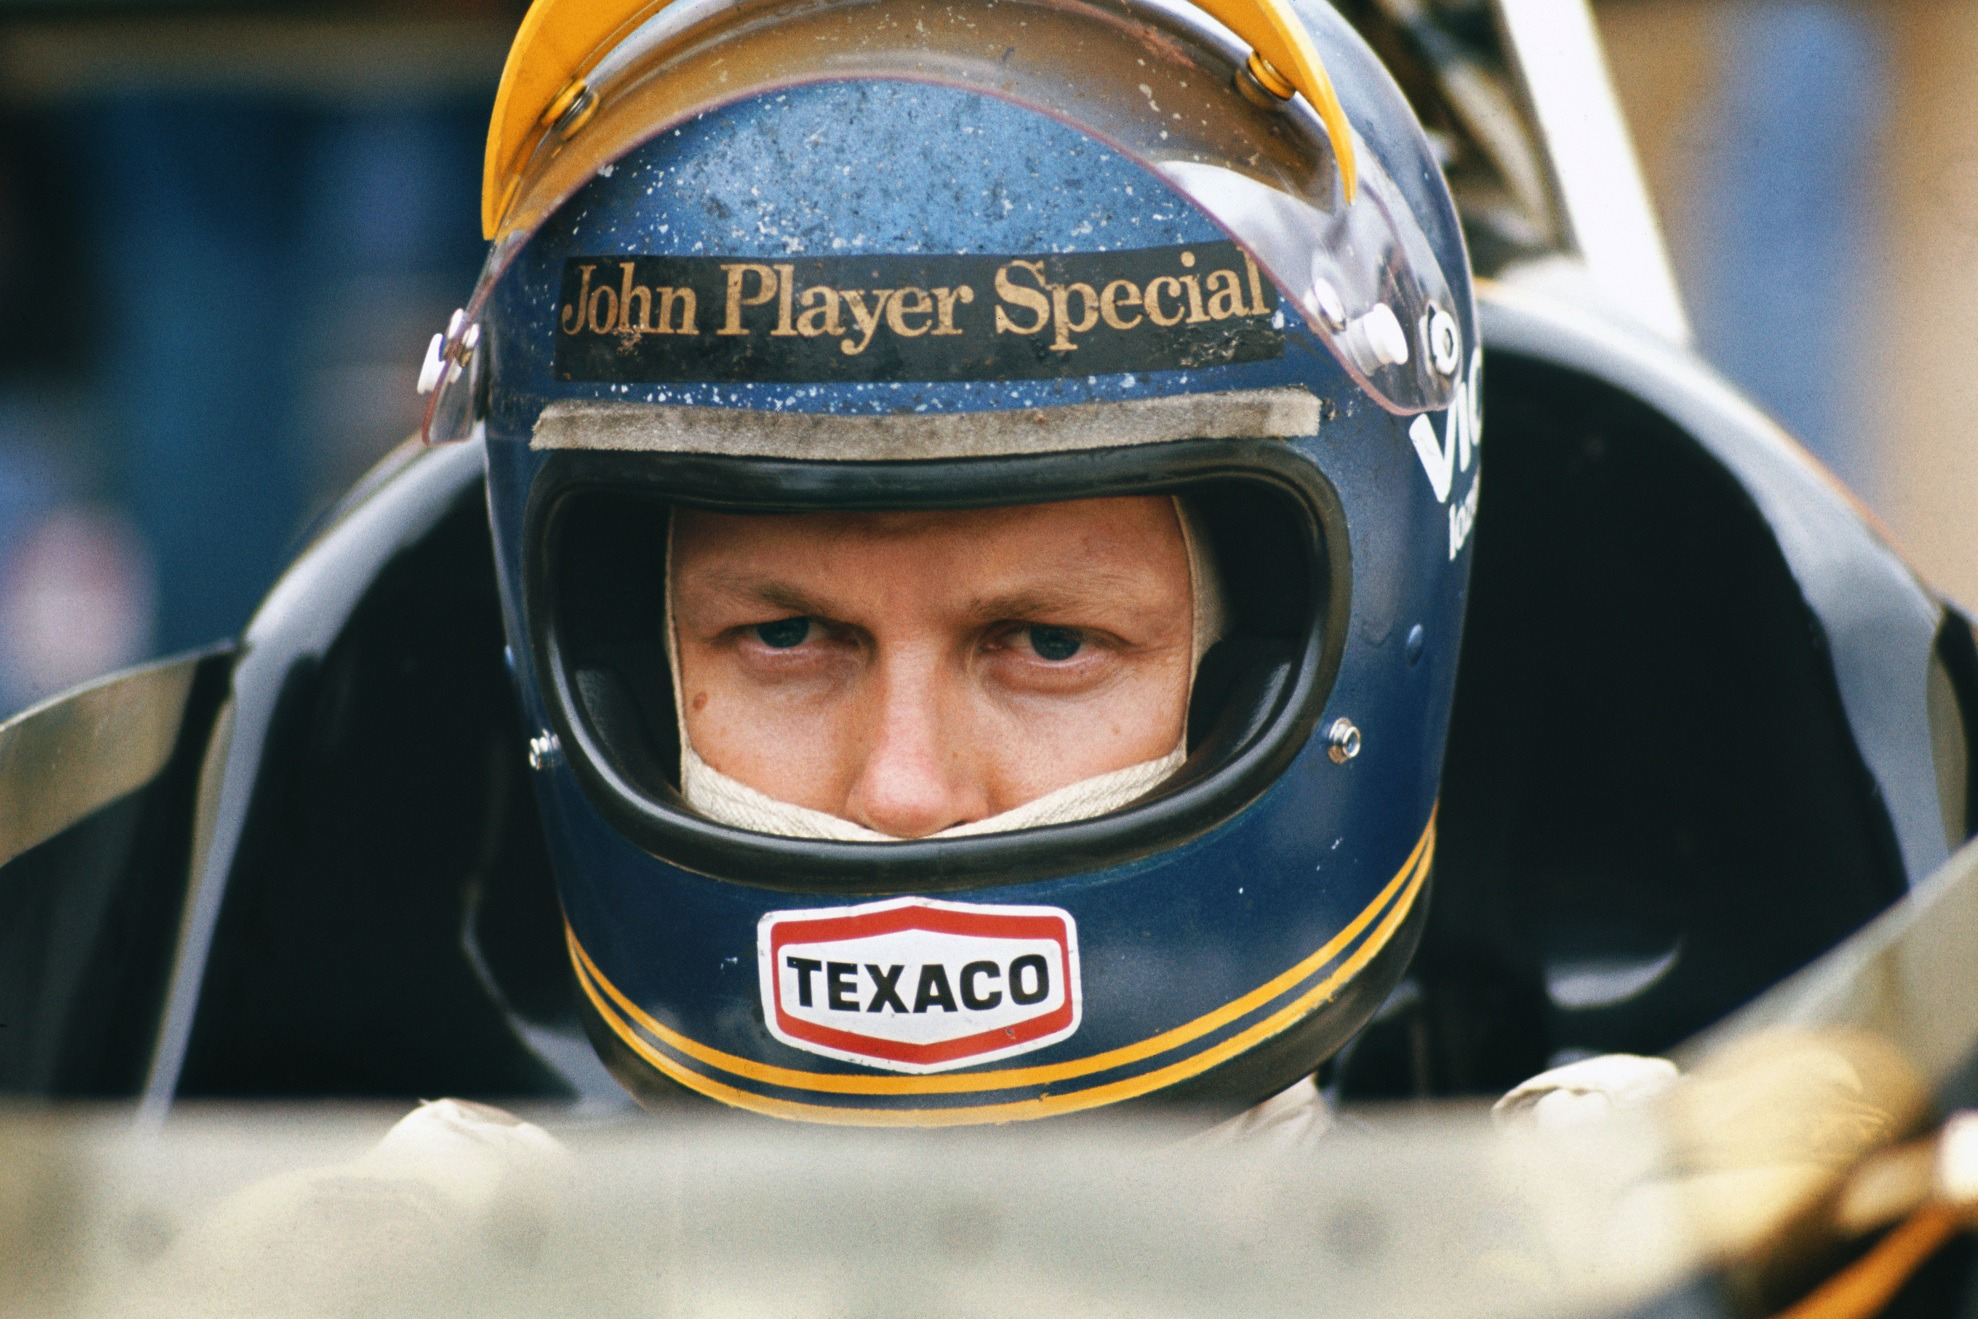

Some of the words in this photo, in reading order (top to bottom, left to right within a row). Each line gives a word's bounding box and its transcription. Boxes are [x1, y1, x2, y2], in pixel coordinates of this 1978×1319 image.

[561, 262, 699, 336] John
[715, 263, 975, 356] Player
[994, 246, 1270, 350] Special
[786, 953, 1050, 1014] TEXACO
